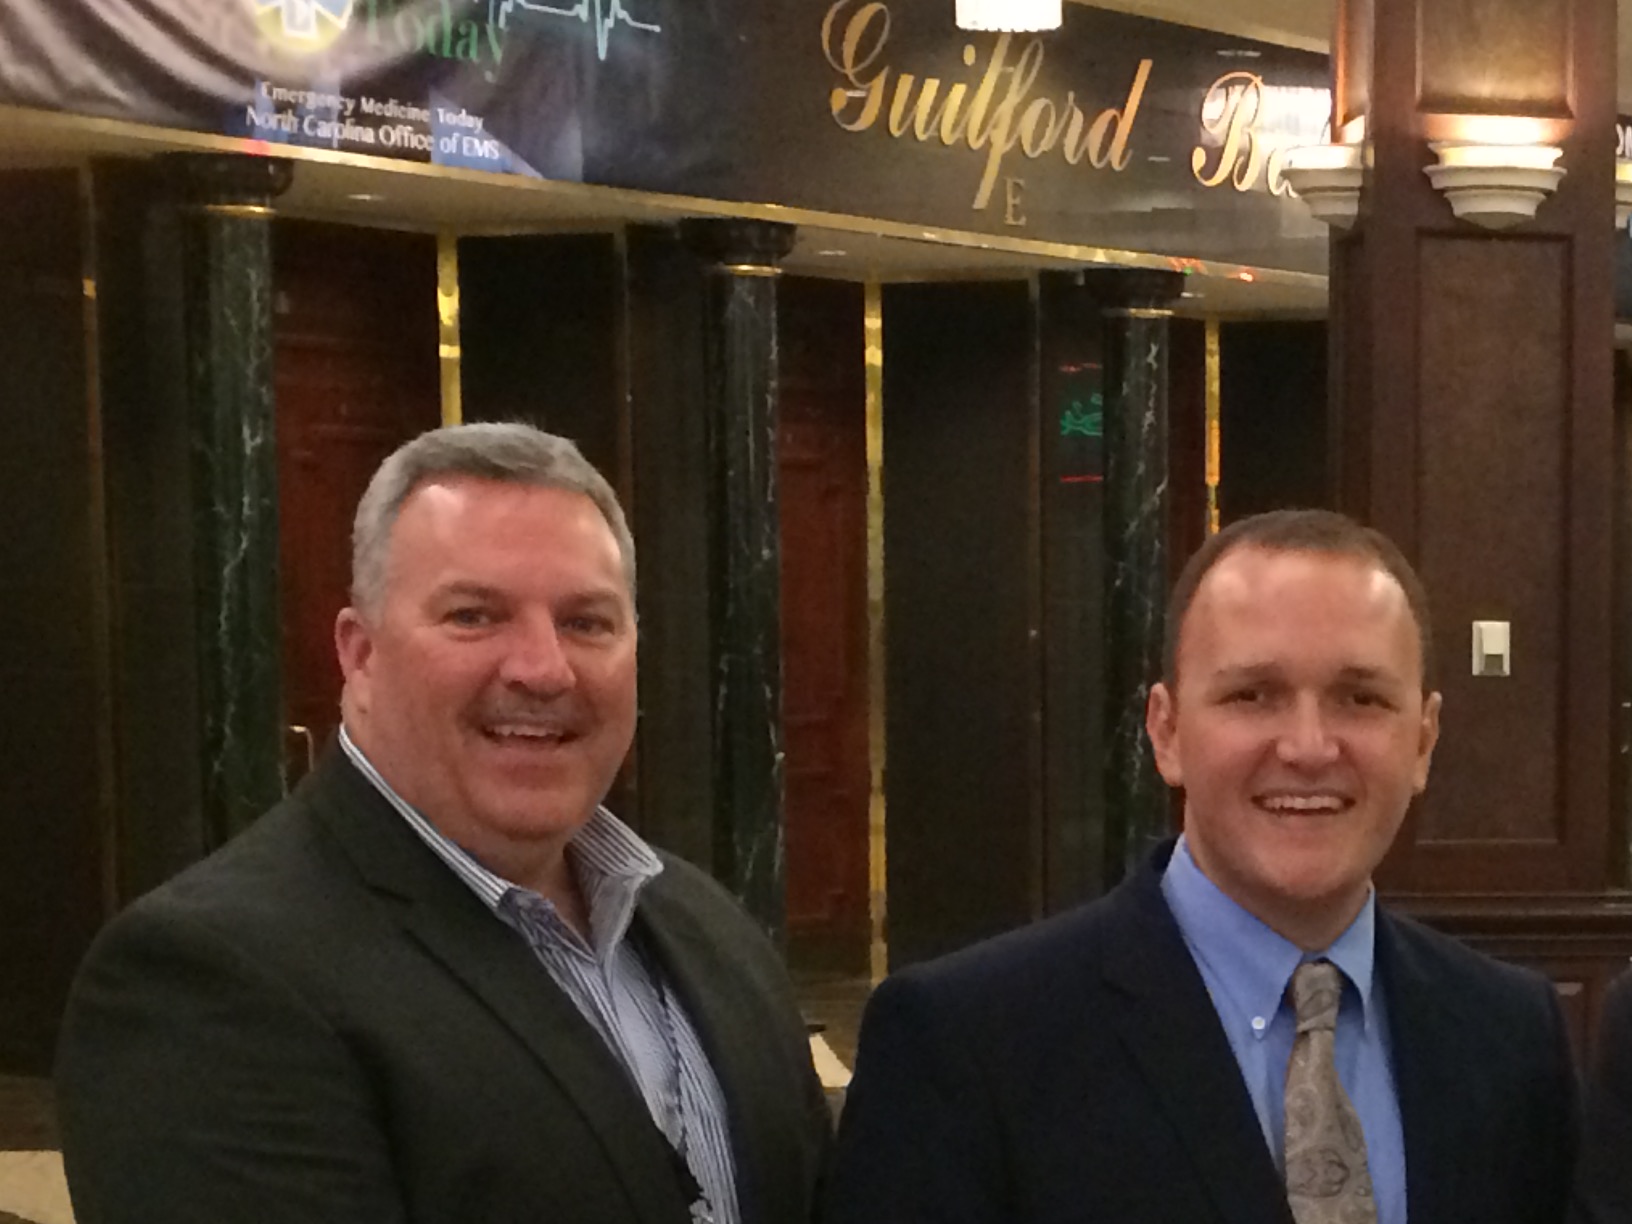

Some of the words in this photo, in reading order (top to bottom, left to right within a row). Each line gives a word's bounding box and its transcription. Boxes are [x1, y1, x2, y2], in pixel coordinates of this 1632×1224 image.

[259, 81, 356, 117] Emergency
[360, 96, 430, 123] Medicine
[437, 107, 484, 131] Today
[821, 0, 1153, 210] Guilford
[246, 105, 298, 134] North
[303, 114, 375, 144] Carolina
[379, 124, 435, 151] Office
[440, 135, 458, 154] of
[462, 137, 500, 160] EMS
[1004, 176, 1028, 226] E
